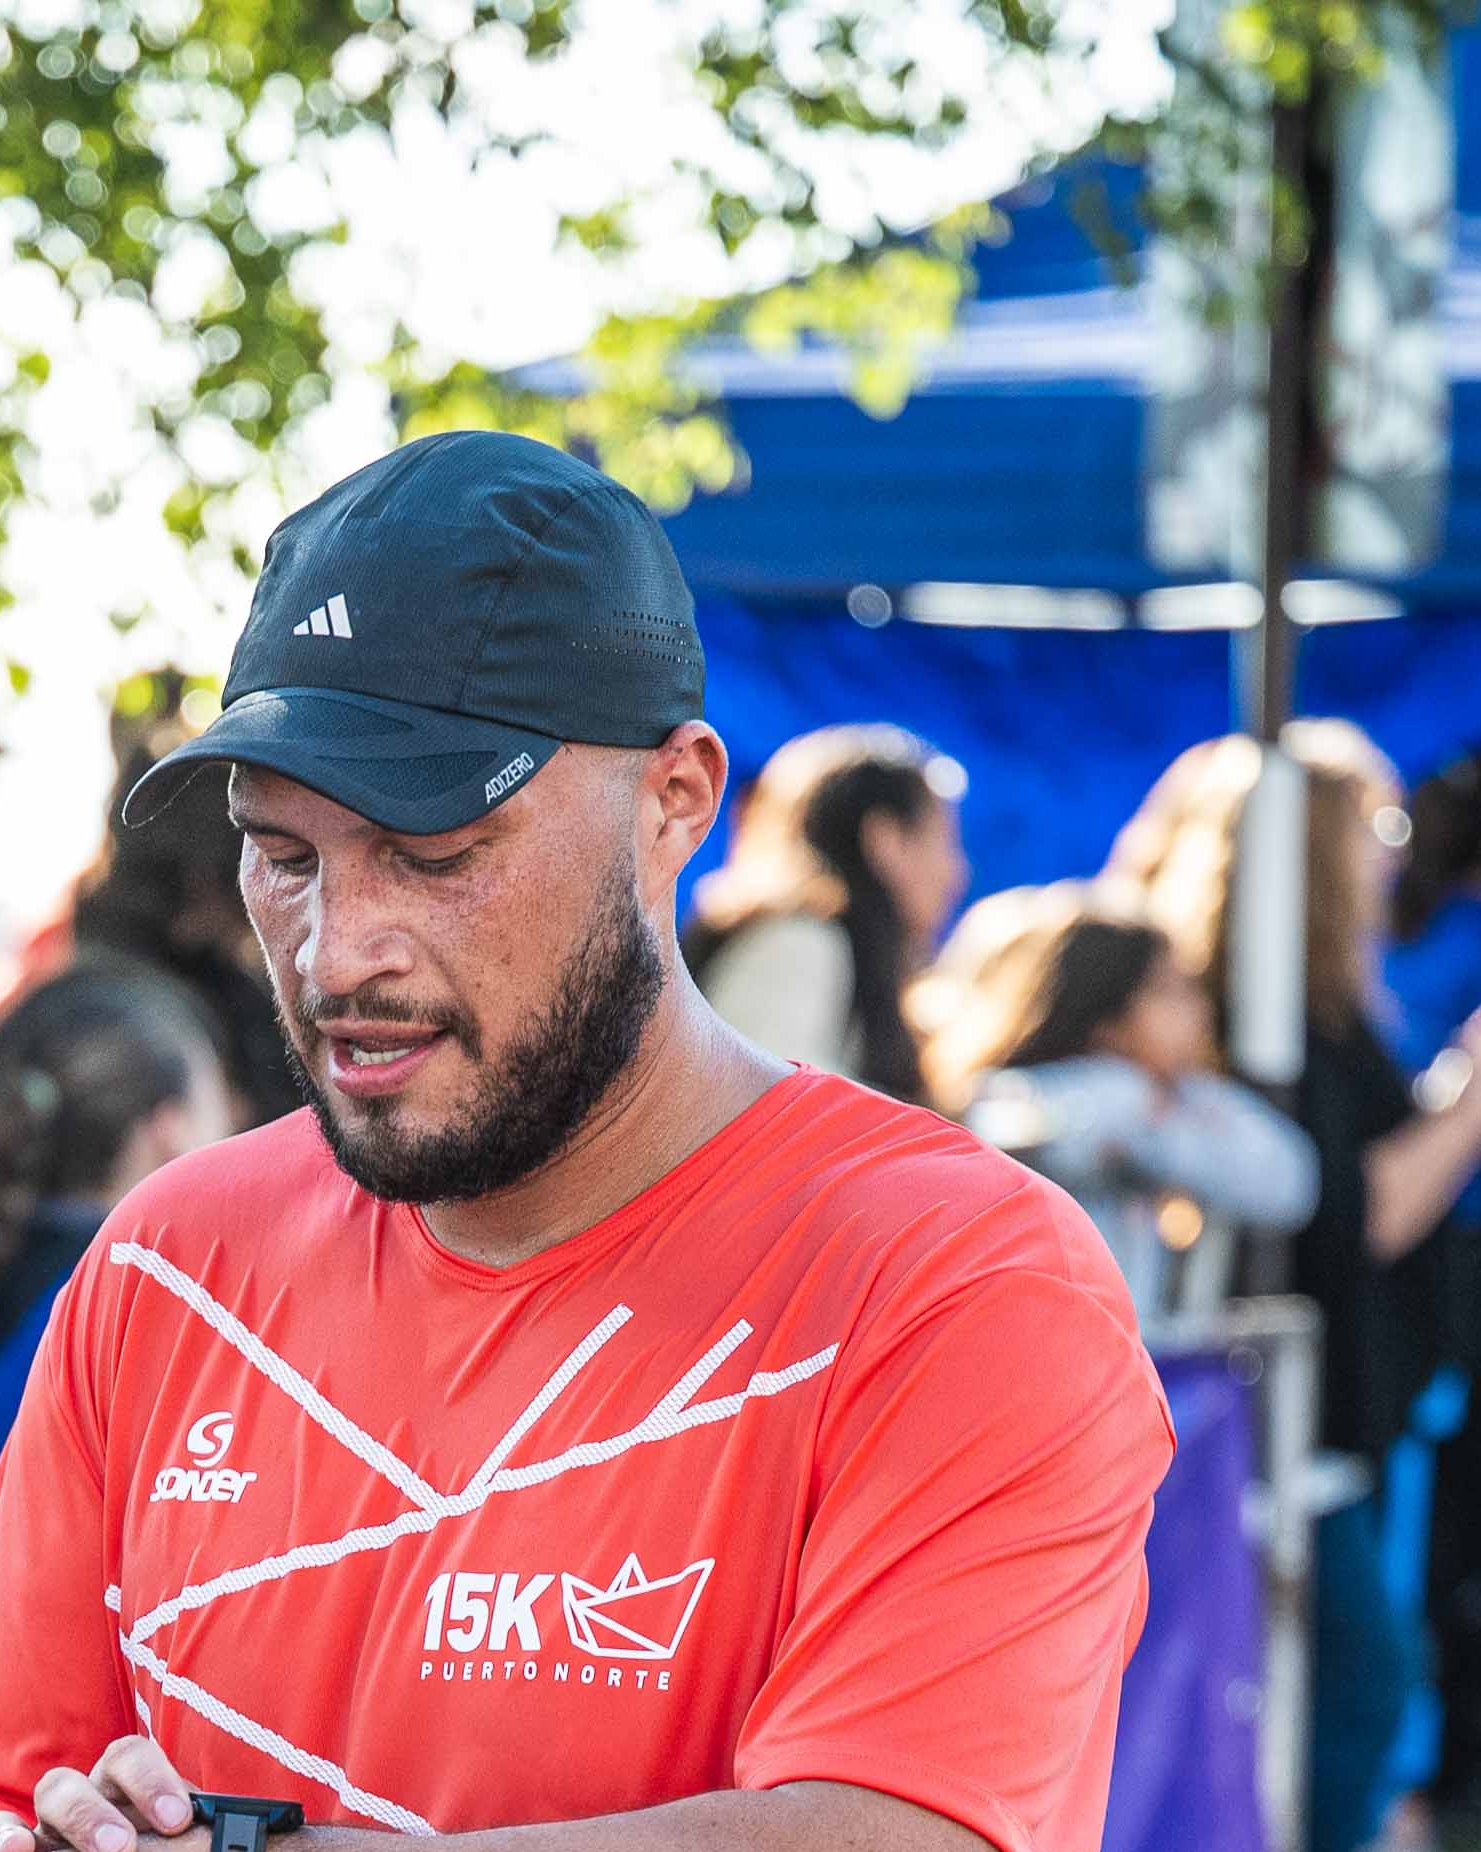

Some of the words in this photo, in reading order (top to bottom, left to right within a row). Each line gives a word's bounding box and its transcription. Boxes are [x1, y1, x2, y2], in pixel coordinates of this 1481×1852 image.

[485, 752, 535, 804] ADIZERO
[423, 1571, 556, 1653] 15K
[420, 1660, 538, 1681] PUERTO
[554, 1662, 671, 1690] NORTE
